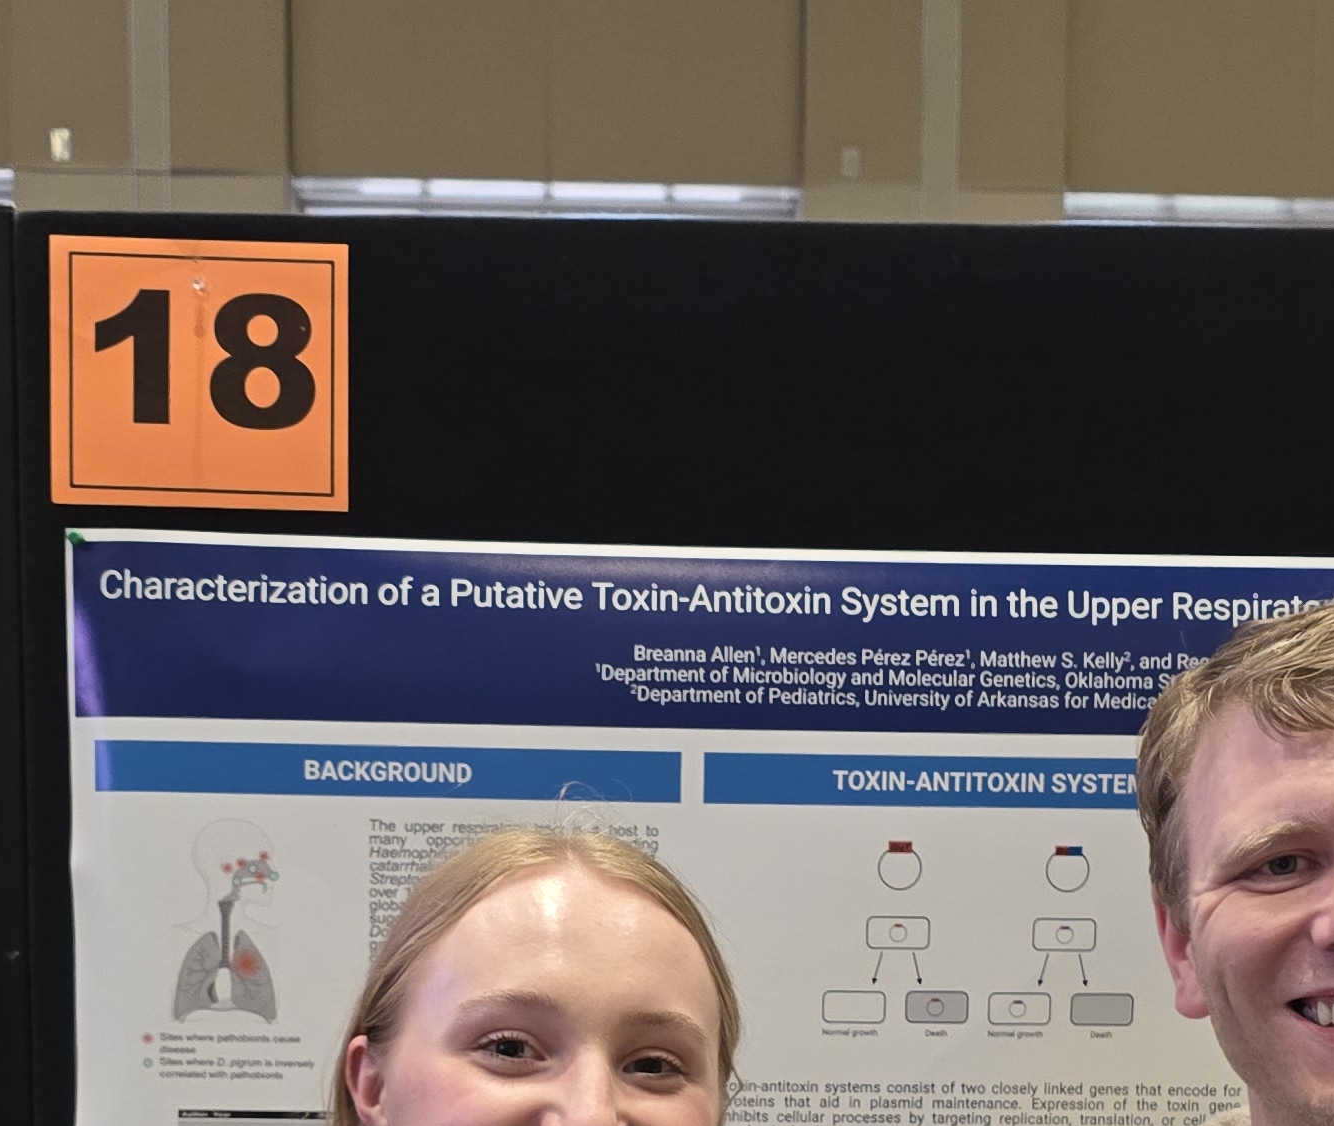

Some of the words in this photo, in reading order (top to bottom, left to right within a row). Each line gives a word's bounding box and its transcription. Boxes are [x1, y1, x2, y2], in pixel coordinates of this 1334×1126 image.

[94, 288, 317, 432] 18
[99, 567, 369, 605] Characterization
[377, 575, 414, 607] of
[420, 583, 440, 607] a
[450, 578, 584, 610] Putative
[590, 581, 831, 615] Toxin-Antitoxin
[840, 585, 960, 624] System
[970, 588, 998, 618] in
[1005, 588, 1059, 619] the
[1067, 589, 1164, 627] Upper
[633, 643, 707, 664] Breanna
[769, 646, 857, 666] Mercedes
[861, 648, 912, 667] Pérez
[979, 649, 1057, 669] Matthew
[1060, 651, 1078, 669] S.
[1138, 651, 1171, 671] and
[709, 665, 730, 684] of
[733, 666, 848, 689] Microbiology
[850, 667, 884, 686] and
[888, 668, 977, 688] Molecular
[979, 669, 1061, 691] Genetics,
[1064, 670, 1154, 691] Oklahoma
[745, 685, 766, 704] of
[768, 685, 861, 709] Pediatrics,
[864, 689, 952, 710] University
[954, 689, 975, 708] of
[976, 690, 1060, 709] Arkansas
[1064, 690, 1090, 710] for
[1094, 692, 1162, 709] Medica
[303, 759, 473, 786] BACKGROUND
[832, 769, 1046, 794] TOXIN-ANTITOXIN
[824, 1080, 882, 1096] systems
[886, 1080, 936, 1095] consist
[941, 1080, 956, 1096] of
[960, 1082, 987, 1096] two
[991, 1081, 1039, 1098] closely
[1043, 1081, 1084, 1096] linked
[1088, 1084, 1130, 1099] genes
[1135, 1082, 1162, 1097] that
[1167, 1082, 1218, 1097] encode
[1223, 1083, 1242, 1098] for
